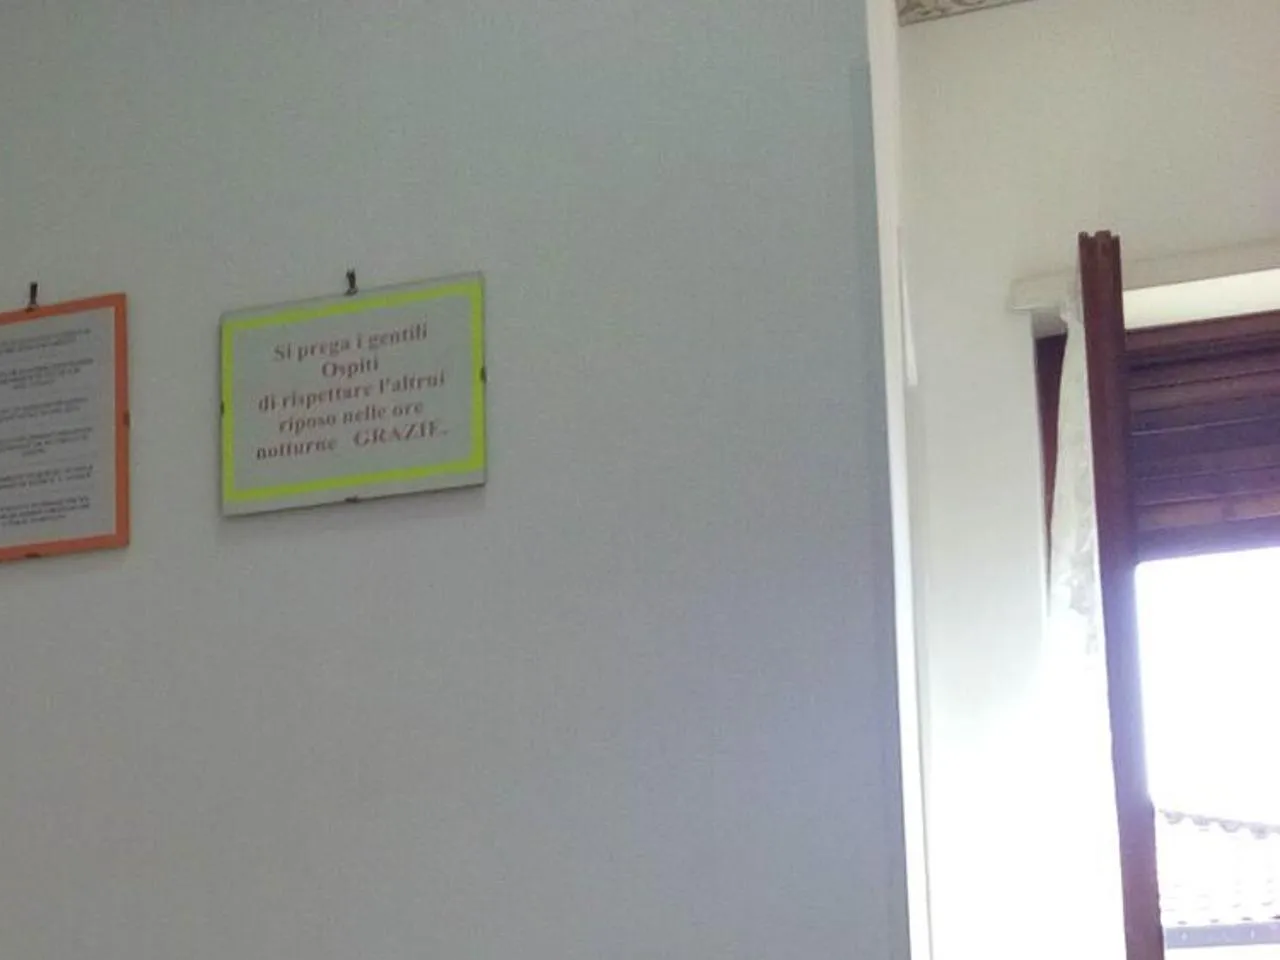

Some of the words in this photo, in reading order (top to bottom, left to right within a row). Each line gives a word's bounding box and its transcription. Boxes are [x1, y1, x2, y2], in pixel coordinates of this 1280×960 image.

[274, 343, 291, 361] Si
[298, 335, 350, 362] prega
[356, 332, 362, 349] i
[367, 319, 428, 350] gentili
[322, 357, 378, 381] Ospiti
[259, 394, 275, 411] di
[282, 382, 372, 411] rispettare
[279, 411, 336, 434] riposo
[343, 406, 386, 425] nelle
[392, 403, 423, 417] ore
[256, 438, 336, 460] notturne
